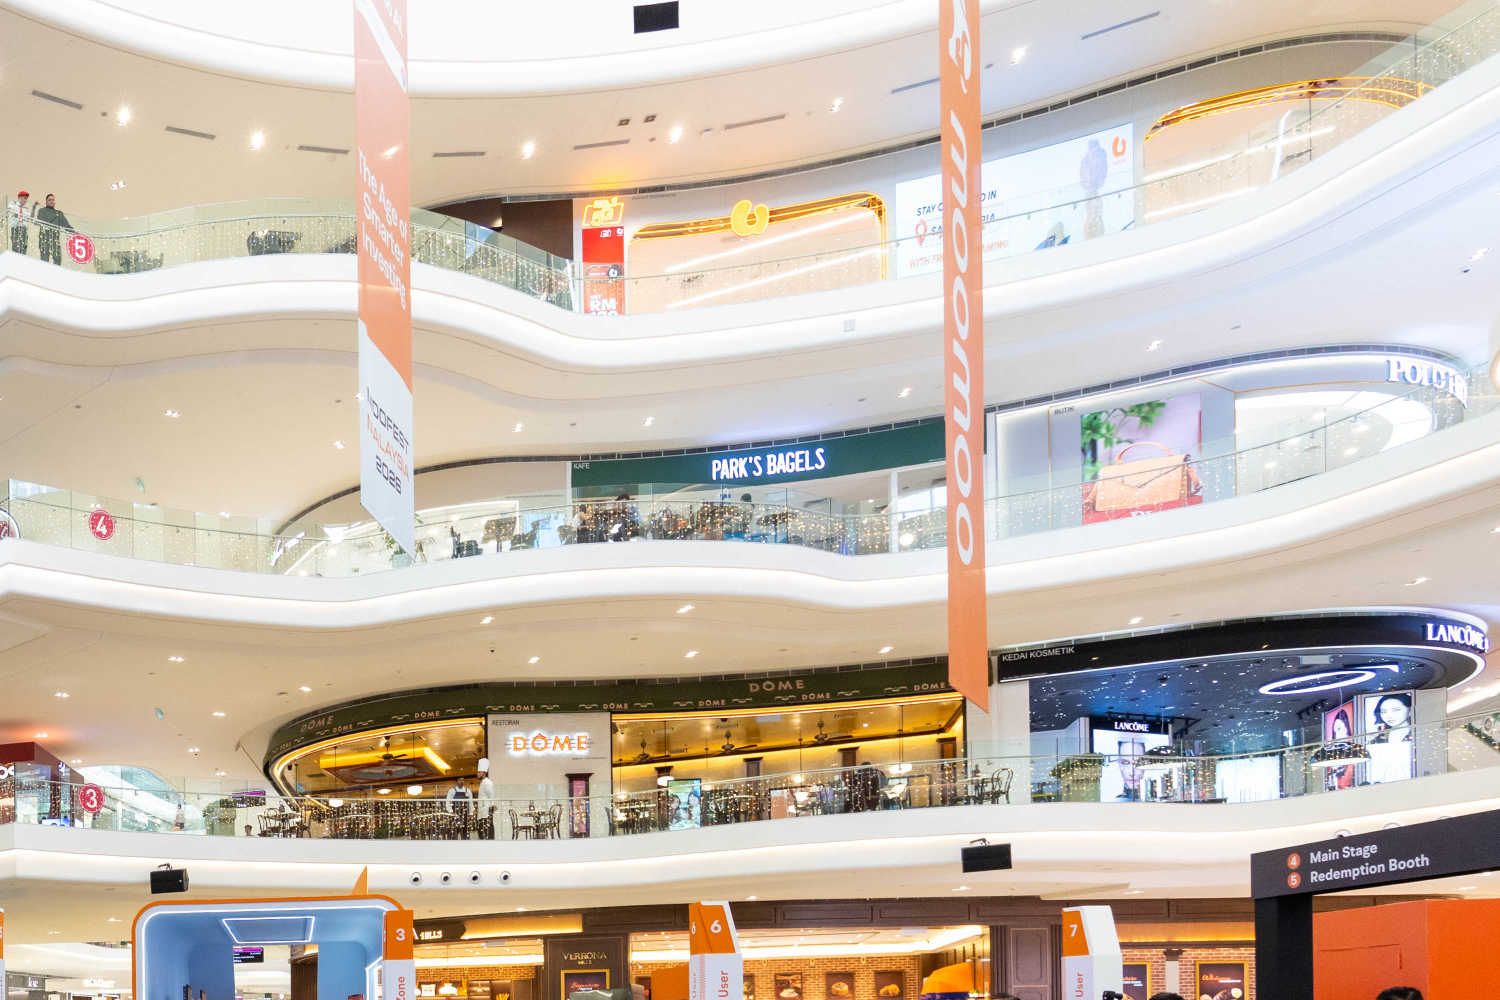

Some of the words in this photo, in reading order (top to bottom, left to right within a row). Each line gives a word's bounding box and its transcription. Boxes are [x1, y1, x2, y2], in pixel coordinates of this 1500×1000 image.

[358, 145, 377, 195] The
[379, 182, 398, 228] Age
[400, 218, 408, 244] of
[916, 203, 937, 217] STAY
[987, 189, 997, 200] IN
[363, 191, 404, 267] Smarter
[74, 238, 87, 259] 5
[362, 221, 406, 311] Investing
[590, 298, 617, 312] RM
[950, 109, 974, 566] moomoo
[1054, 406, 1074, 415] BUTIK
[573, 462, 590, 470] KAFE
[711, 454, 762, 481] PARK'S
[766, 447, 826, 476] BAGELS
[376, 454, 402, 495] 2026
[95, 515, 108, 535] 4
[1002, 652, 1028, 662] KEDAI
[1030, 646, 1075, 659] KOSMETIK
[749, 679, 805, 693] DÔME
[1114, 720, 1150, 733] LANCÔME
[513, 732, 589, 752] DÔME
[86, 788, 98, 808] 3
[1310, 849, 1339, 864] Main
[1342, 843, 1378, 859] Stage
[1310, 863, 1385, 884] Redemption
[1388, 855, 1430, 870] Booth
[395, 928, 406, 941] 3
[710, 919, 722, 934] 6
[1069, 924, 1078, 937] 7
[563, 951, 607, 961] VERRONA
[718, 971, 730, 998] User
[1075, 972, 1084, 998] User
